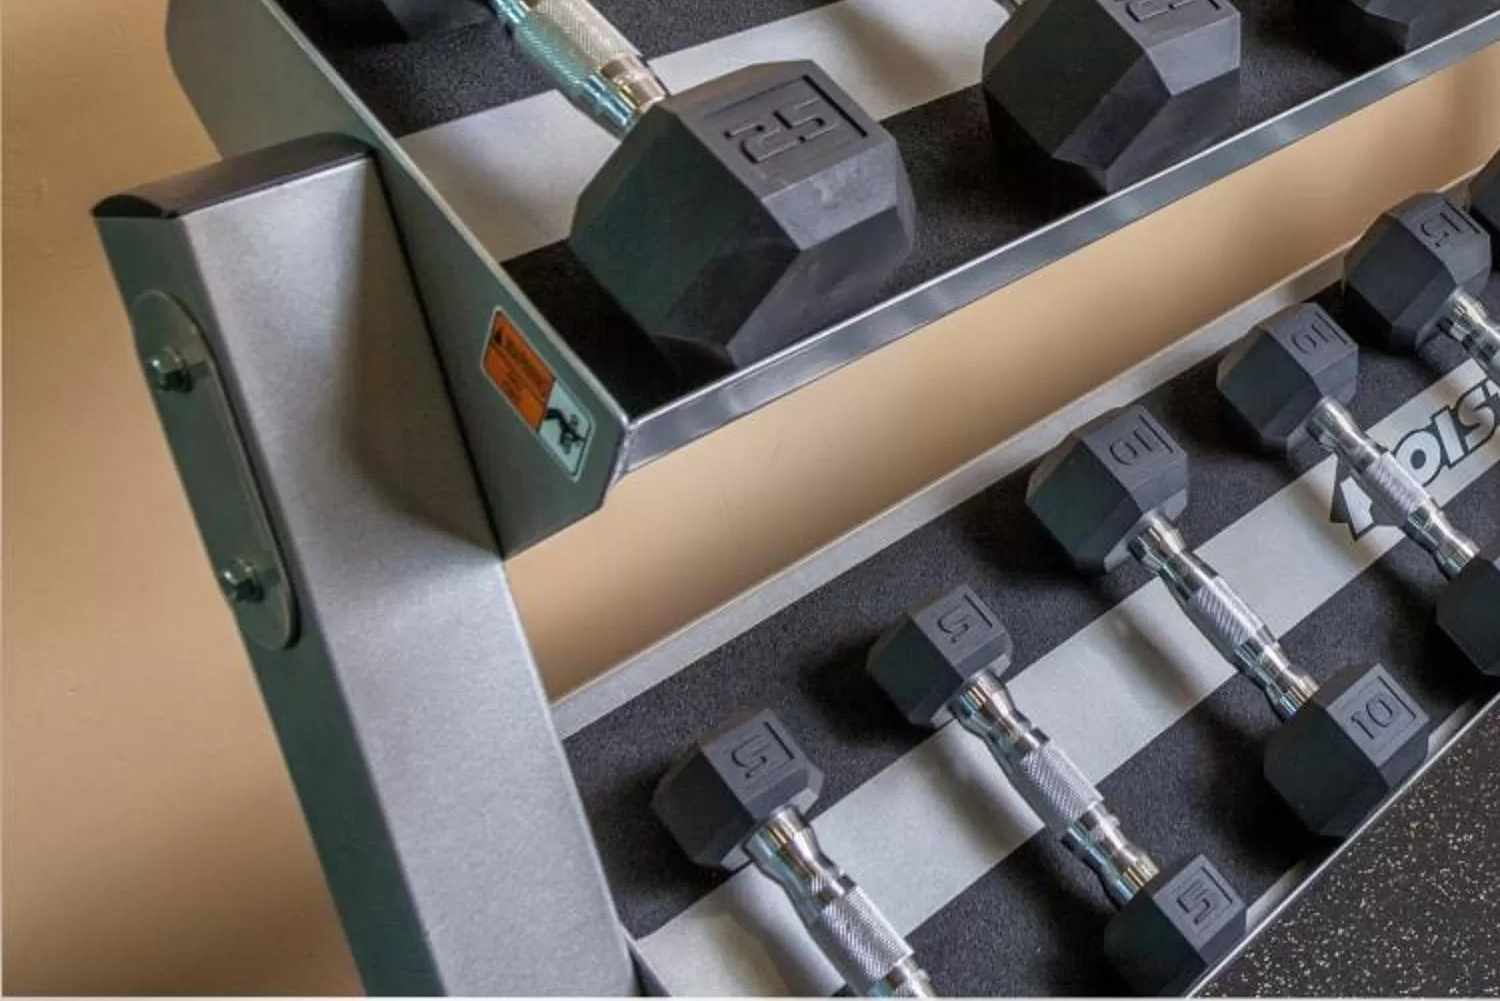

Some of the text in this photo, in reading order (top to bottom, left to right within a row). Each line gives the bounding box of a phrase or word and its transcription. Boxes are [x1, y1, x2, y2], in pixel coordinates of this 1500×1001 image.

[722, 95, 842, 165] 25
[1419, 211, 1463, 249] 15
[1290, 322, 1332, 355] 10
[1109, 424, 1161, 467] 10
[937, 605, 973, 646] 5
[1351, 693, 1399, 740] 10
[731, 732, 775, 780] 5
[1176, 879, 1215, 927] 5
